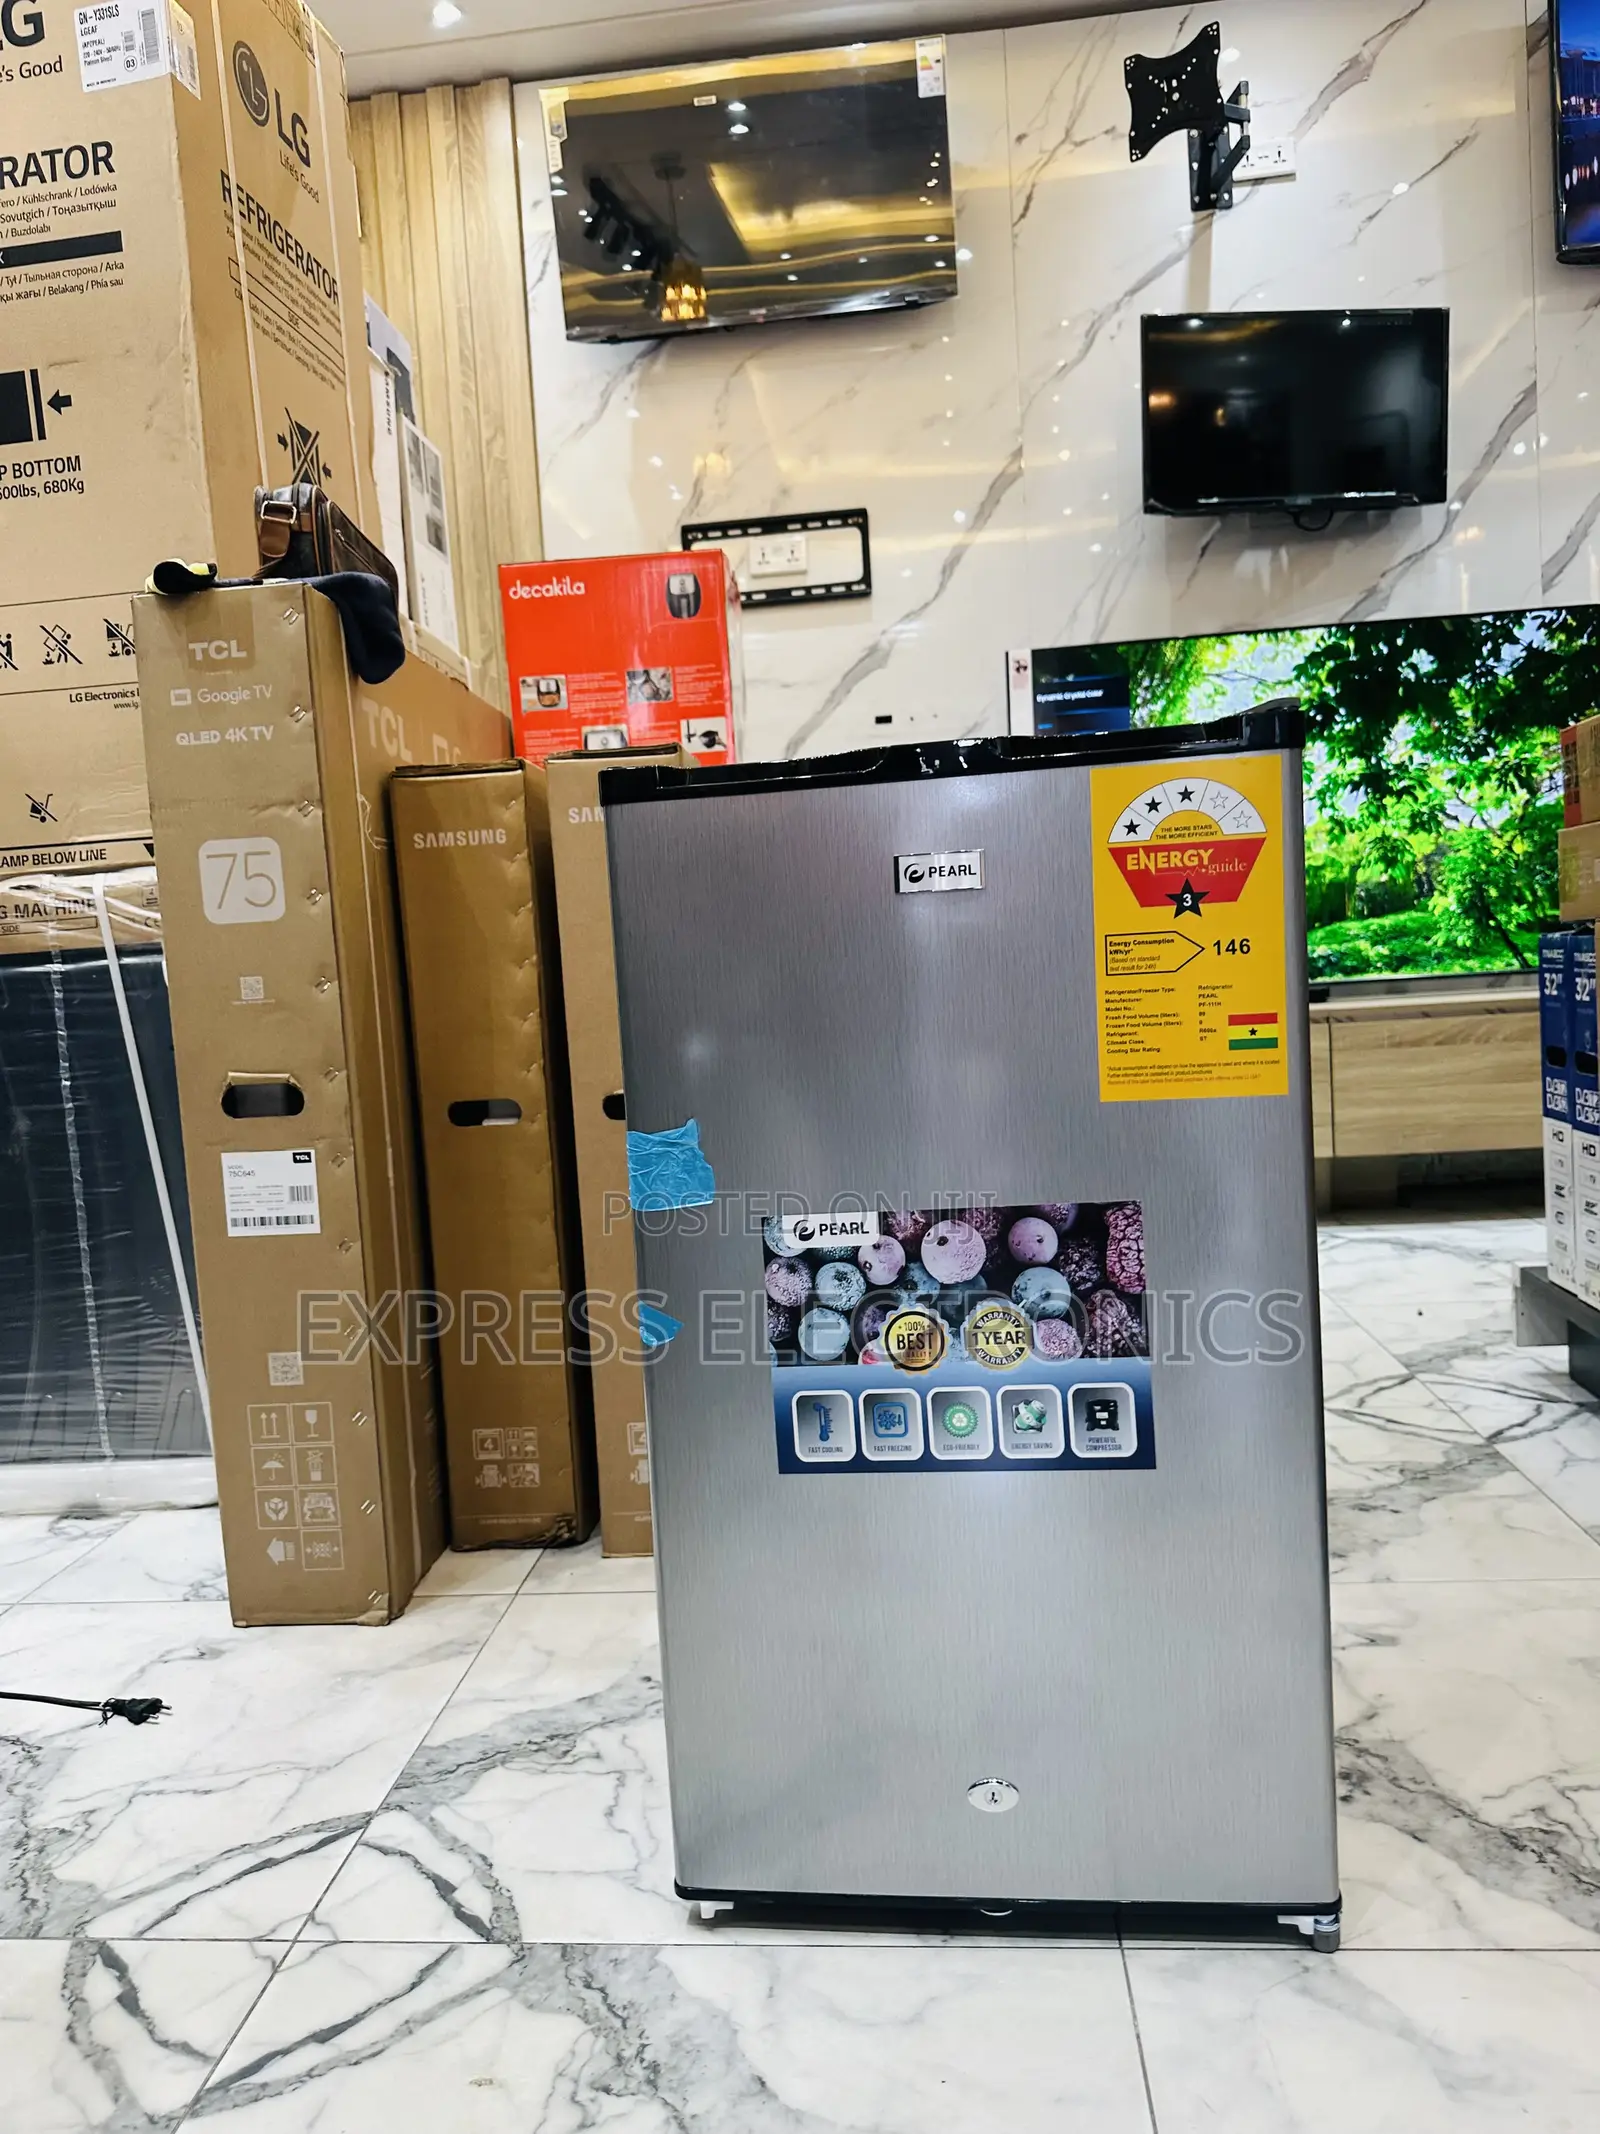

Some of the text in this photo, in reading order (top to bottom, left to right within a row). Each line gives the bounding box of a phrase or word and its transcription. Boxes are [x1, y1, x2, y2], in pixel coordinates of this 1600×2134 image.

[19, 54, 63, 79] Good
[126, 59, 135, 68] 03
[274, 88, 311, 168] LG
[0, 140, 116, 190] RATOR
[22, 189, 73, 205] Kühlschrank
[80, 182, 117, 196] Lodówka
[300, 173, 320, 203] Good
[105, 261, 124, 272] Arka
[48, 284, 84, 296] Belakang
[110, 278, 124, 287] sau
[12, 455, 82, 479] BOTTOM
[44, 478, 85, 494] 680Kg
[509, 576, 586, 600] decakila
[188, 639, 248, 661] TCL
[69, 688, 135, 703] LG Electronics
[198, 684, 272, 704] Google TV
[176, 725, 274, 746] QLED 4K TV
[361, 695, 413, 764] TCL
[413, 828, 507, 850] SAMSUNG
[1187, 831, 1218, 839] EFFICIENT
[0, 848, 107, 868] AMP BELOW LINE
[1126, 848, 1248, 875] ENERGY guide
[928, 864, 977, 878] PEARL
[206, 851, 276, 910] 75
[1183, 894, 1192, 907] 3
[1109, 937, 1175, 948] Energy Consumption
[1212, 938, 1251, 955] 146
[1552, 1128, 1564, 1143] HD
[1582, 1142, 1597, 1158] HD
[819, 1221, 870, 1237] PEARL
[904, 1320, 926, 1332] 100%
[976, 1311, 1020, 1328] WARRANTY
[896, 1332, 934, 1350] BEST
[977, 1348, 1022, 1365] WARRANTY
[887, 1444, 912, 1452] FREEZING
[1011, 1442, 1032, 1450] ENERGY
